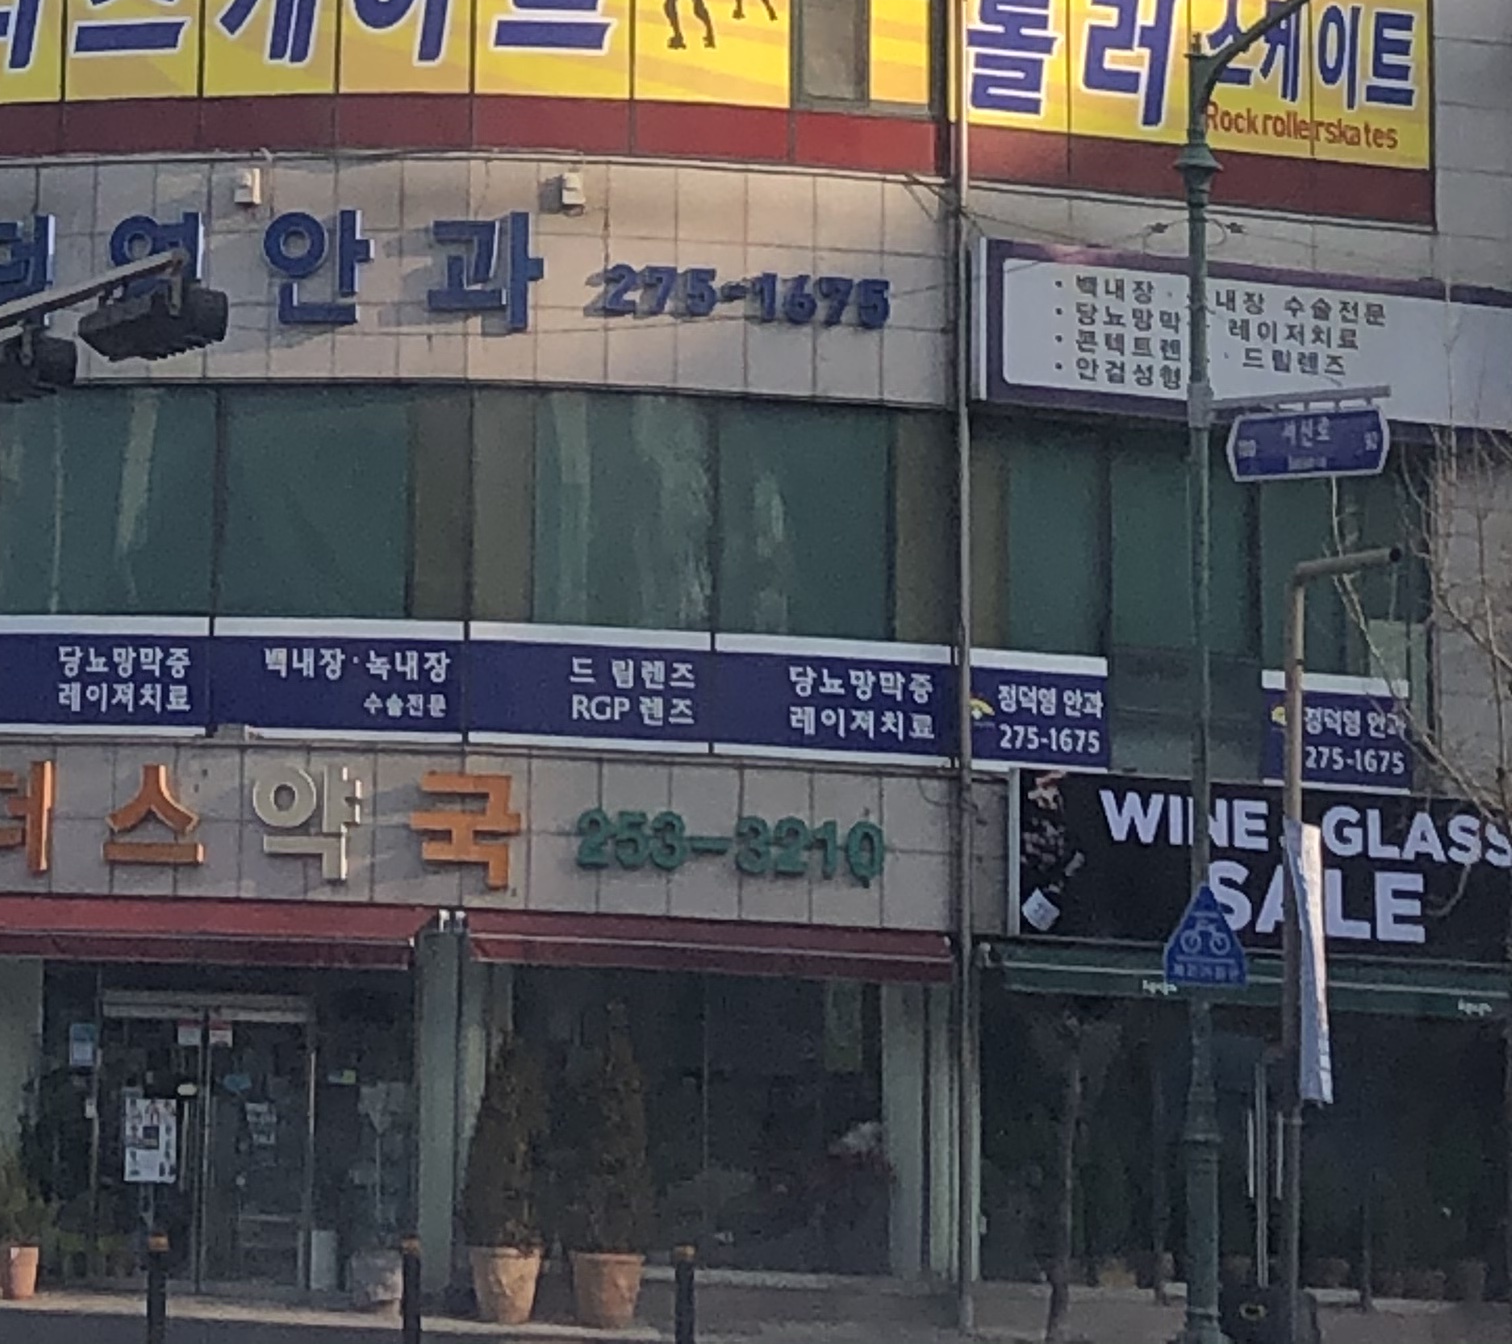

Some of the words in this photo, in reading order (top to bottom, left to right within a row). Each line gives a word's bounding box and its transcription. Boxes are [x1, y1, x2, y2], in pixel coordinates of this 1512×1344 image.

[594, 262, 891, 330] 275-1675
[1075, 275, 1155, 304] 백내장
[1283, 295, 1386, 328] 수술전문
[1075, 301, 1210, 334] 당뇨망막
[1227, 318, 1359, 350] 레이저치료
[58, 645, 192, 679] 당뇨망막증
[789, 665, 934, 703] 당뇨망막증
[363, 692, 448, 719] 수술전문
[570, 695, 631, 722] RGP
[638, 697, 696, 727] 렌즈
[999, 724, 1101, 755] 275-1675
[1304, 744, 1406, 777] 275-1675
[576, 807, 886, 888] 253-3210
[1098, 789, 1271, 853] WINE
[1321, 804, 1512, 869] GLASS
